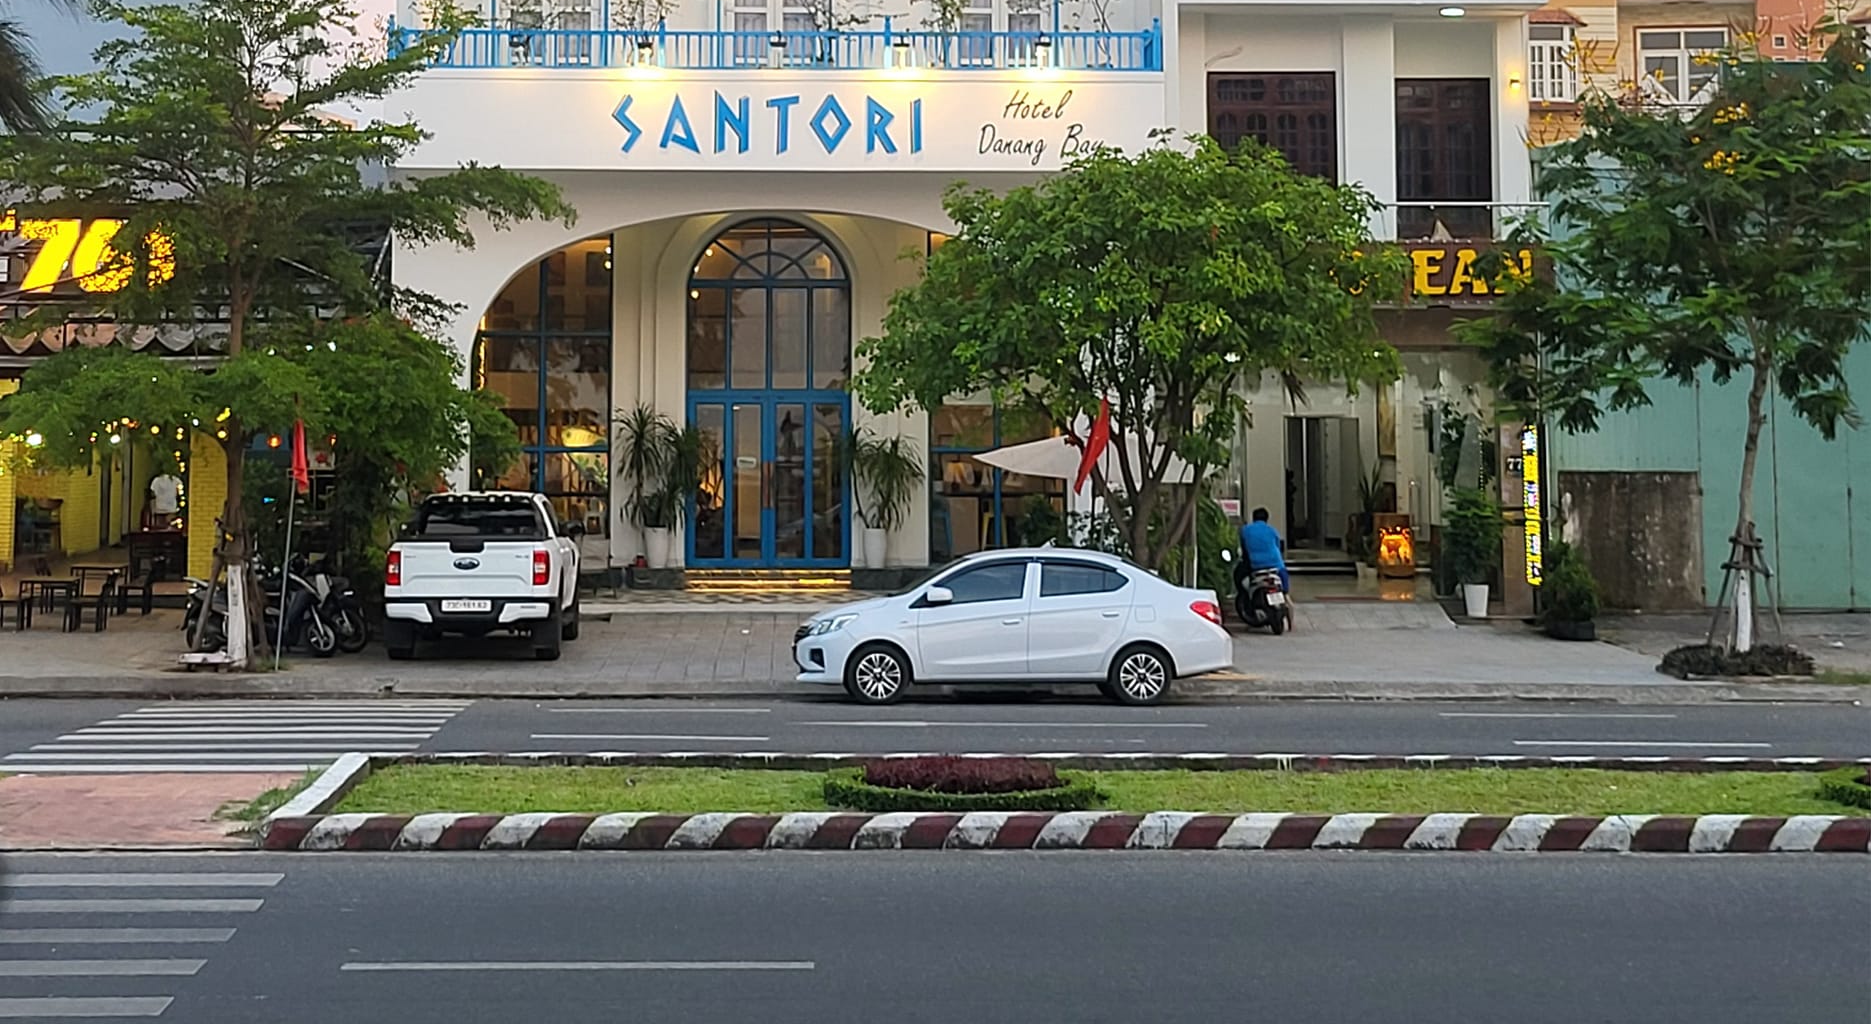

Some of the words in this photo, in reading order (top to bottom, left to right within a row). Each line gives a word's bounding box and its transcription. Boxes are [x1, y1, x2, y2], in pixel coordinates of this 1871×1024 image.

[612, 89, 923, 154] SANTORI
[1003, 89, 1073, 120] Hotel
[978, 123, 1048, 167] Danang
[1060, 123, 1105, 159] Bay
